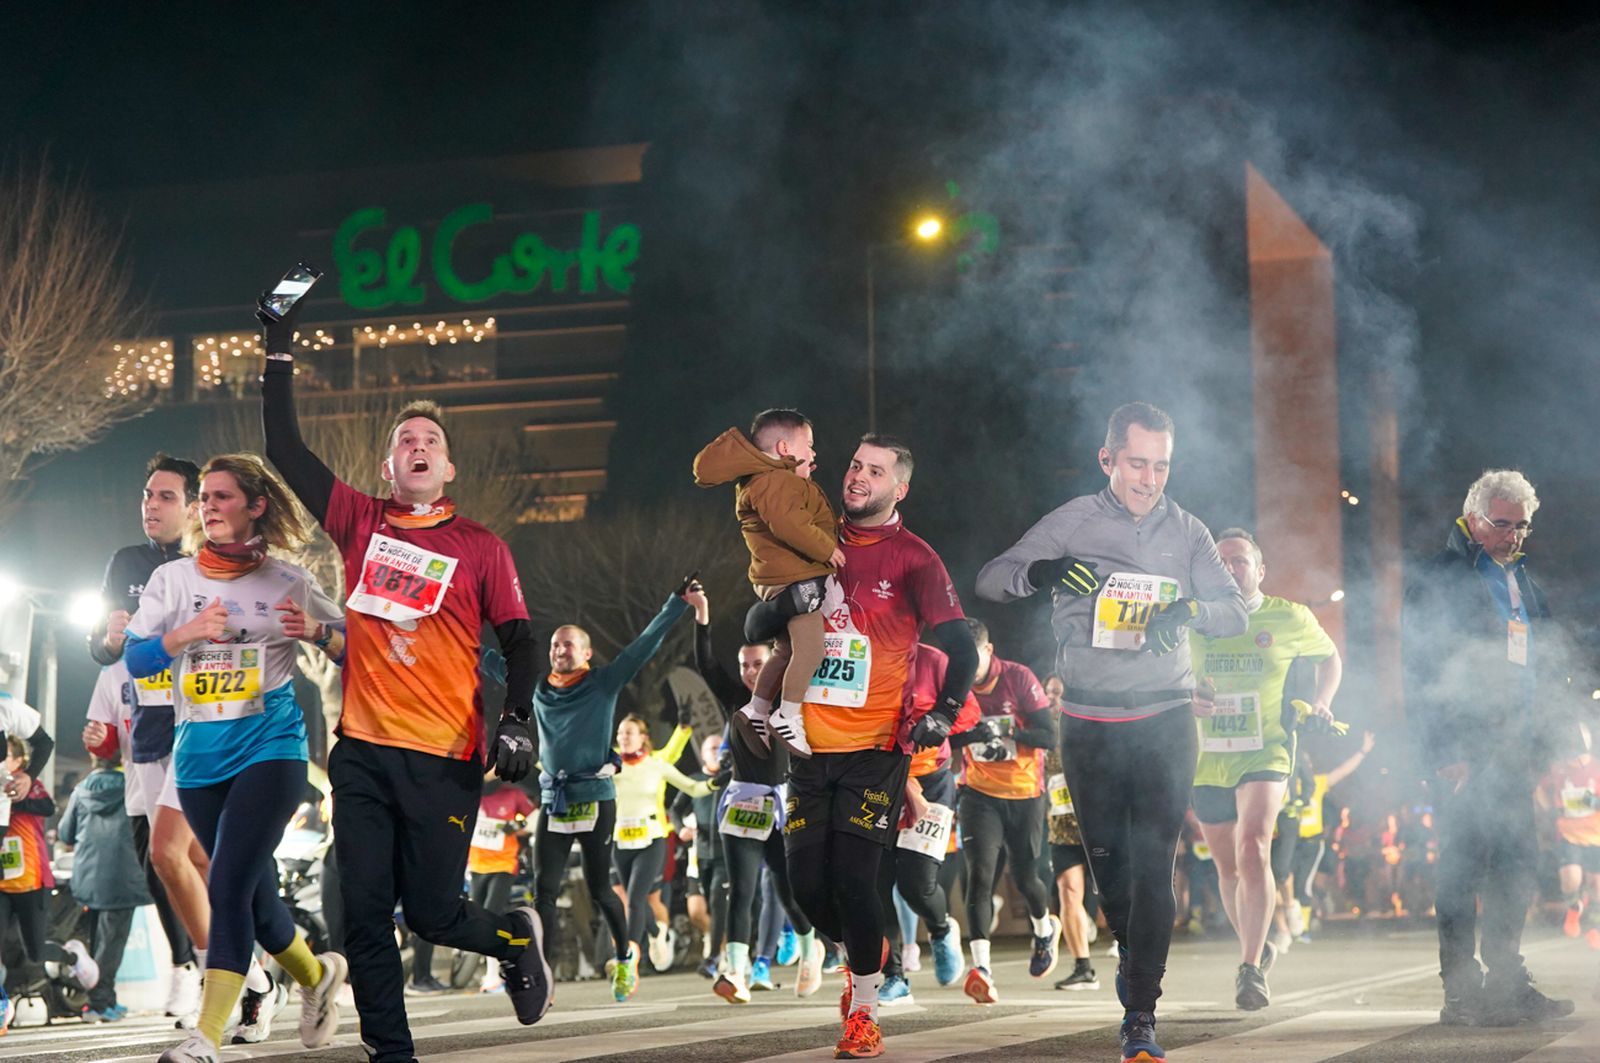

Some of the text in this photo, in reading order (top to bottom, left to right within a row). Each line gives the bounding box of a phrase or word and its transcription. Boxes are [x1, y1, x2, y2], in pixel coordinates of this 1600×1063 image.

[333, 203, 642, 309] El Corte
[373, 553, 389, 563] SAN
[389, 558, 419, 573] ANTON
[387, 548, 411, 562] NOCHE
[412, 556, 423, 565] DE
[373, 565, 427, 600] 9812
[1117, 581, 1140, 591] NOCHE
[1143, 583, 1153, 591] DE
[1106, 589, 1153, 601] SAN ANTON
[813, 658, 855, 682] 825
[195, 670, 246, 695] 5722
[1210, 714, 1248, 732] 1442
[915, 818, 945, 840] 3721
